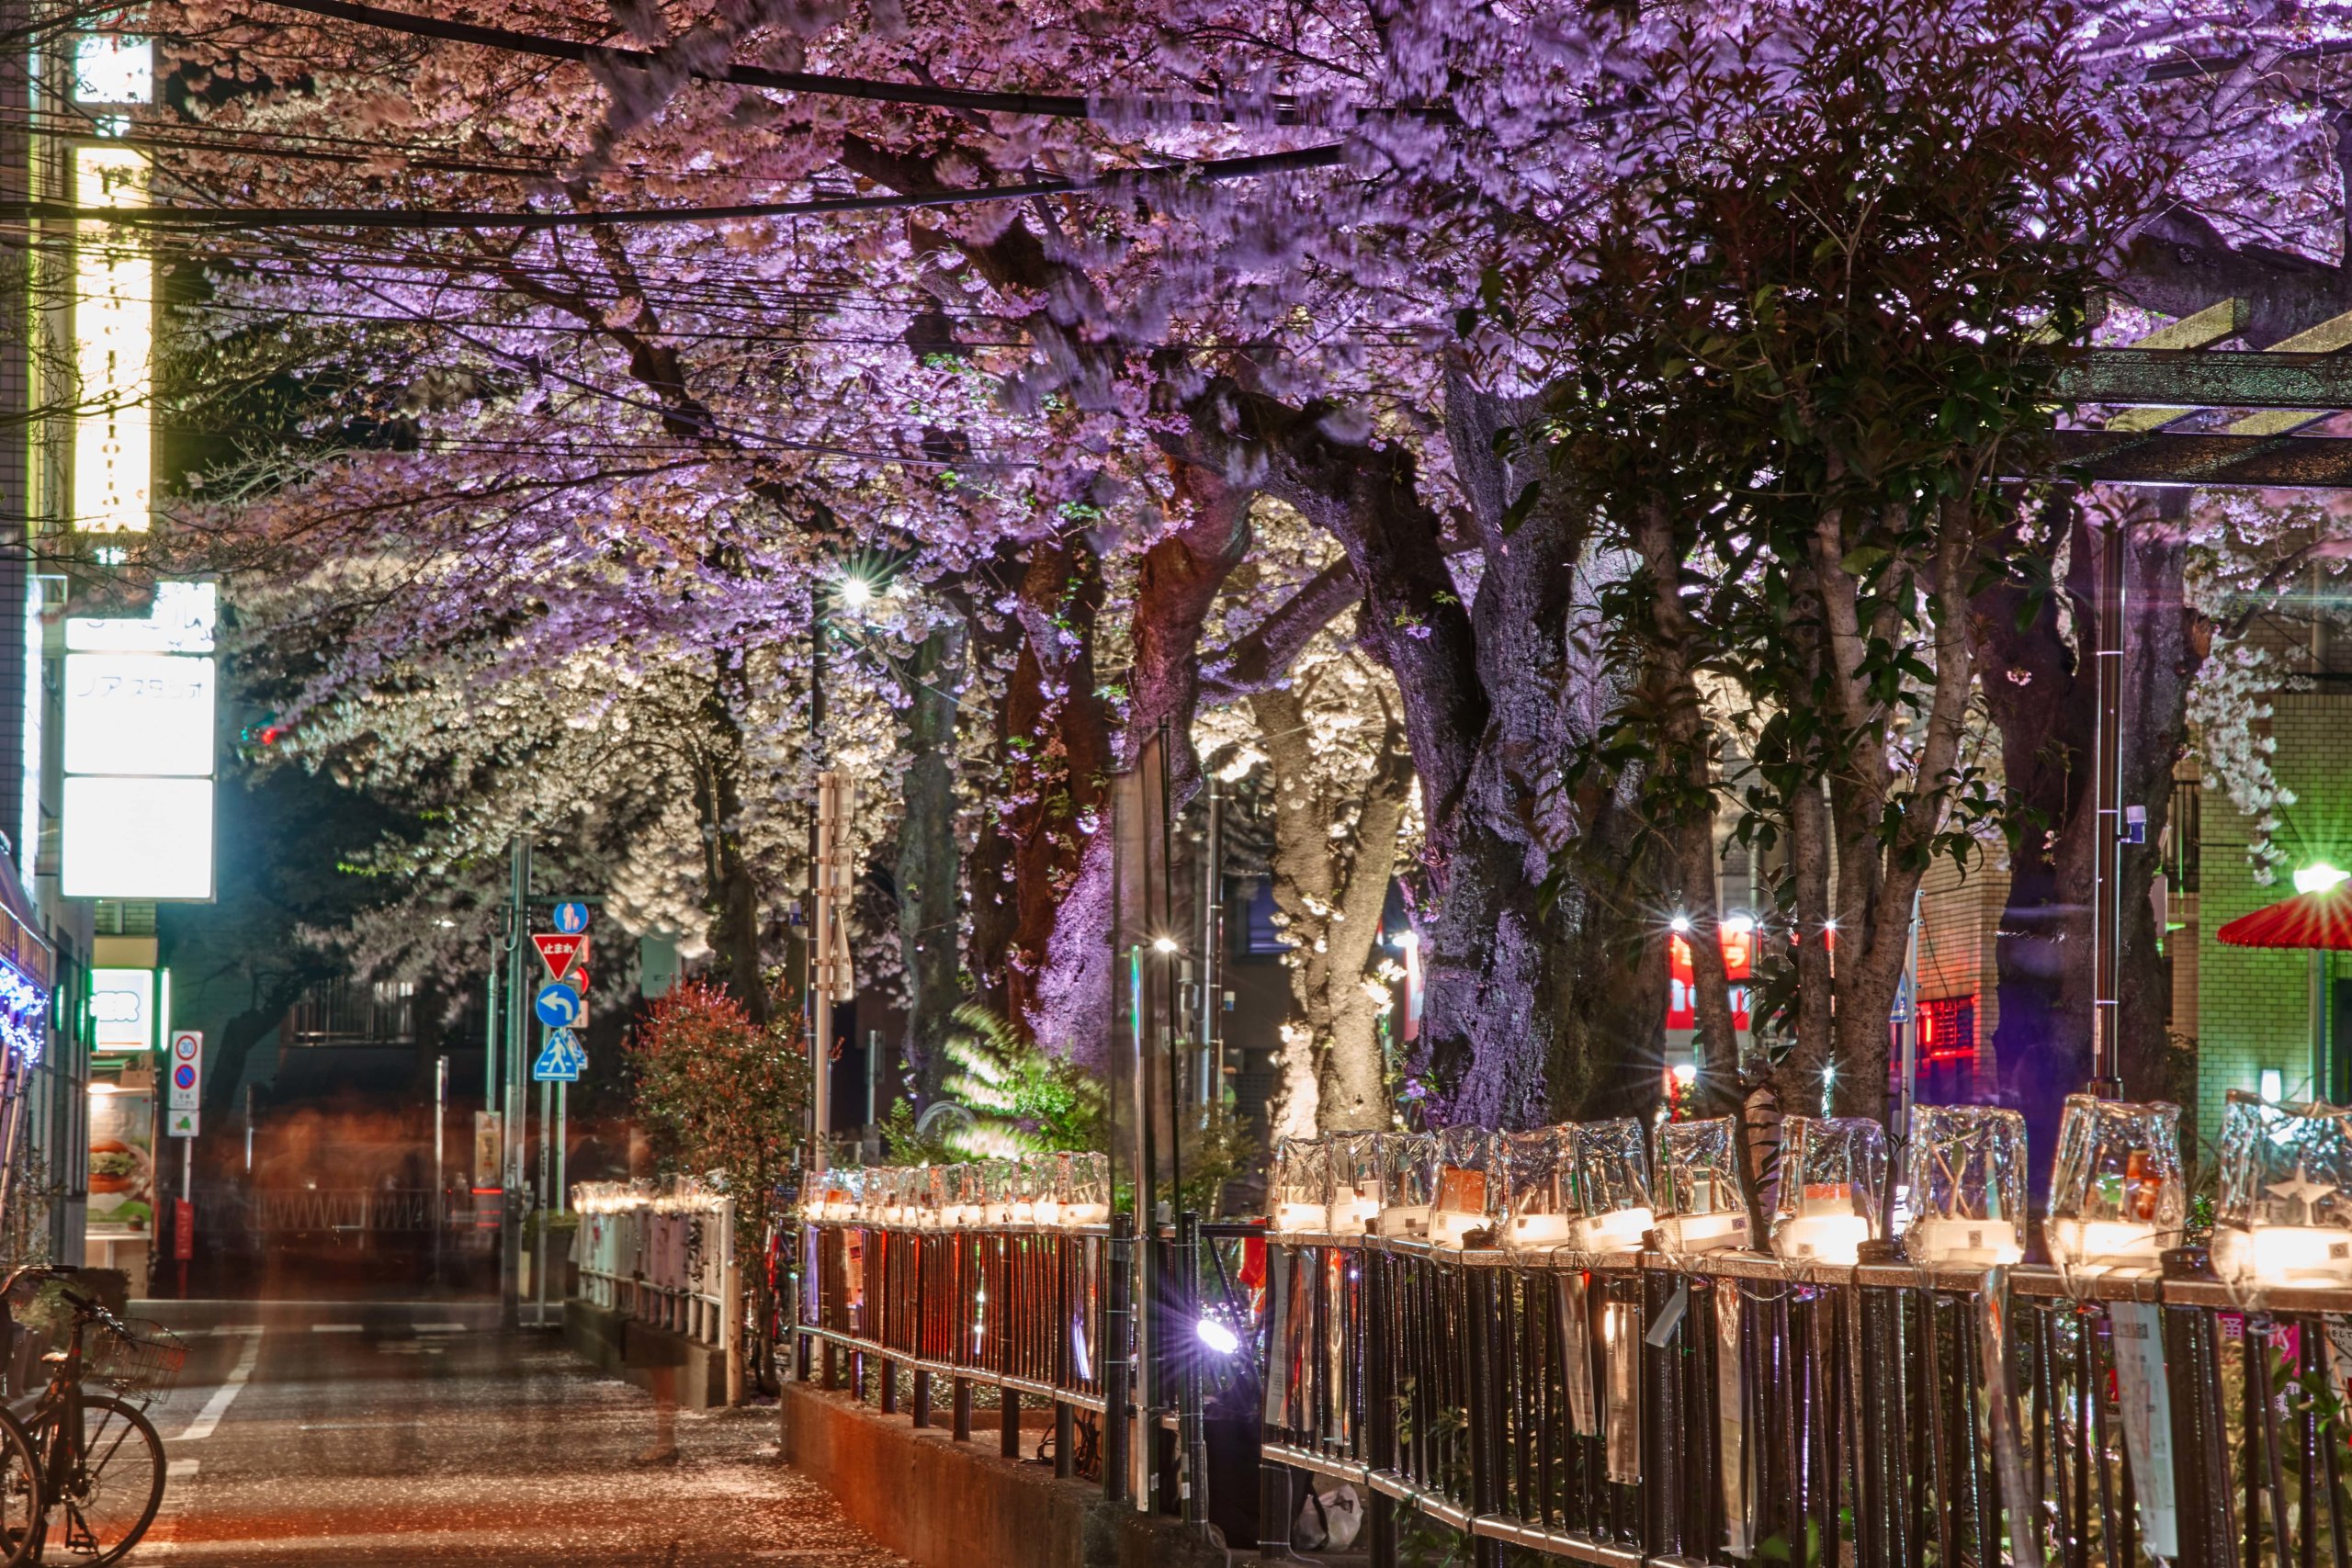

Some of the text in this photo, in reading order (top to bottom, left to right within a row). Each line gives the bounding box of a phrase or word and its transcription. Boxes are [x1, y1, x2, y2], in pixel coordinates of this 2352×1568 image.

[543, 942, 574, 954] 止まれ
[179, 1042, 193, 1054] 30
